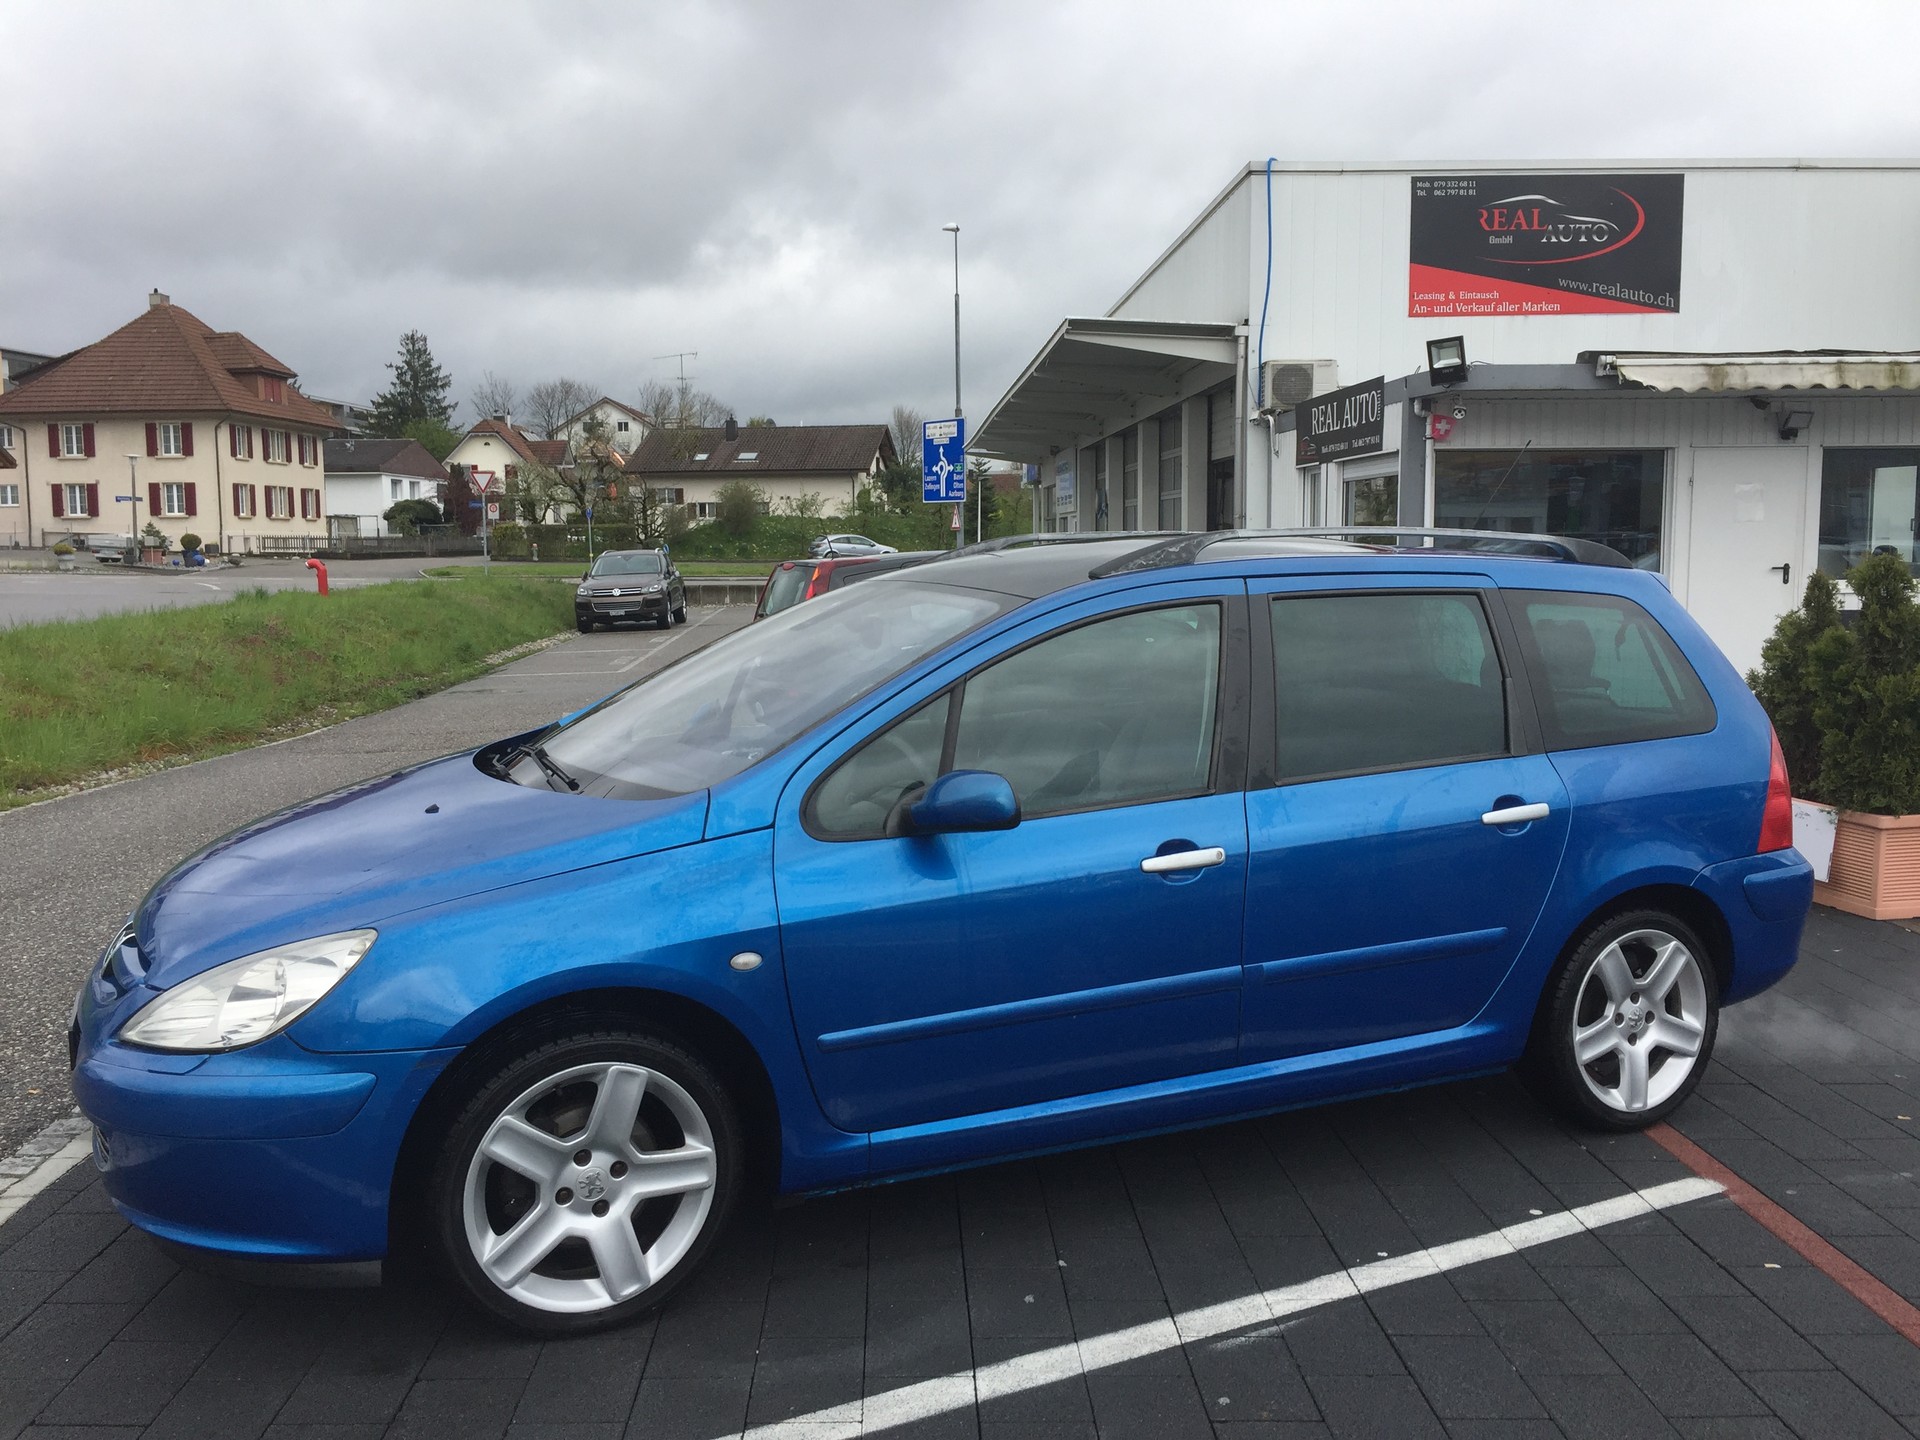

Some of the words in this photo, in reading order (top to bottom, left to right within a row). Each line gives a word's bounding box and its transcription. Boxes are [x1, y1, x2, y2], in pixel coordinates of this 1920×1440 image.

[1459, 180, 1468, 188] 68
[1469, 180, 1476, 188] 11
[1478, 208, 1548, 231] REAL
[1488, 235, 1513, 244] GmbH
[1540, 223, 1609, 243] AUTO
[1413, 291, 1445, 301] Leasing
[1448, 290, 1456, 300] &
[1459, 291, 1500, 300] Eintausch
[1558, 278, 1675, 308] www.realauto.ch
[1413, 303, 1432, 314] An-
[1433, 303, 1453, 313] und
[1455, 302, 1496, 313] Verkauf
[1496, 302, 1520, 312] aller
[1522, 301, 1561, 312] Marken
[1311, 401, 1341, 436] REAL
[1341, 390, 1378, 429] AUTO
